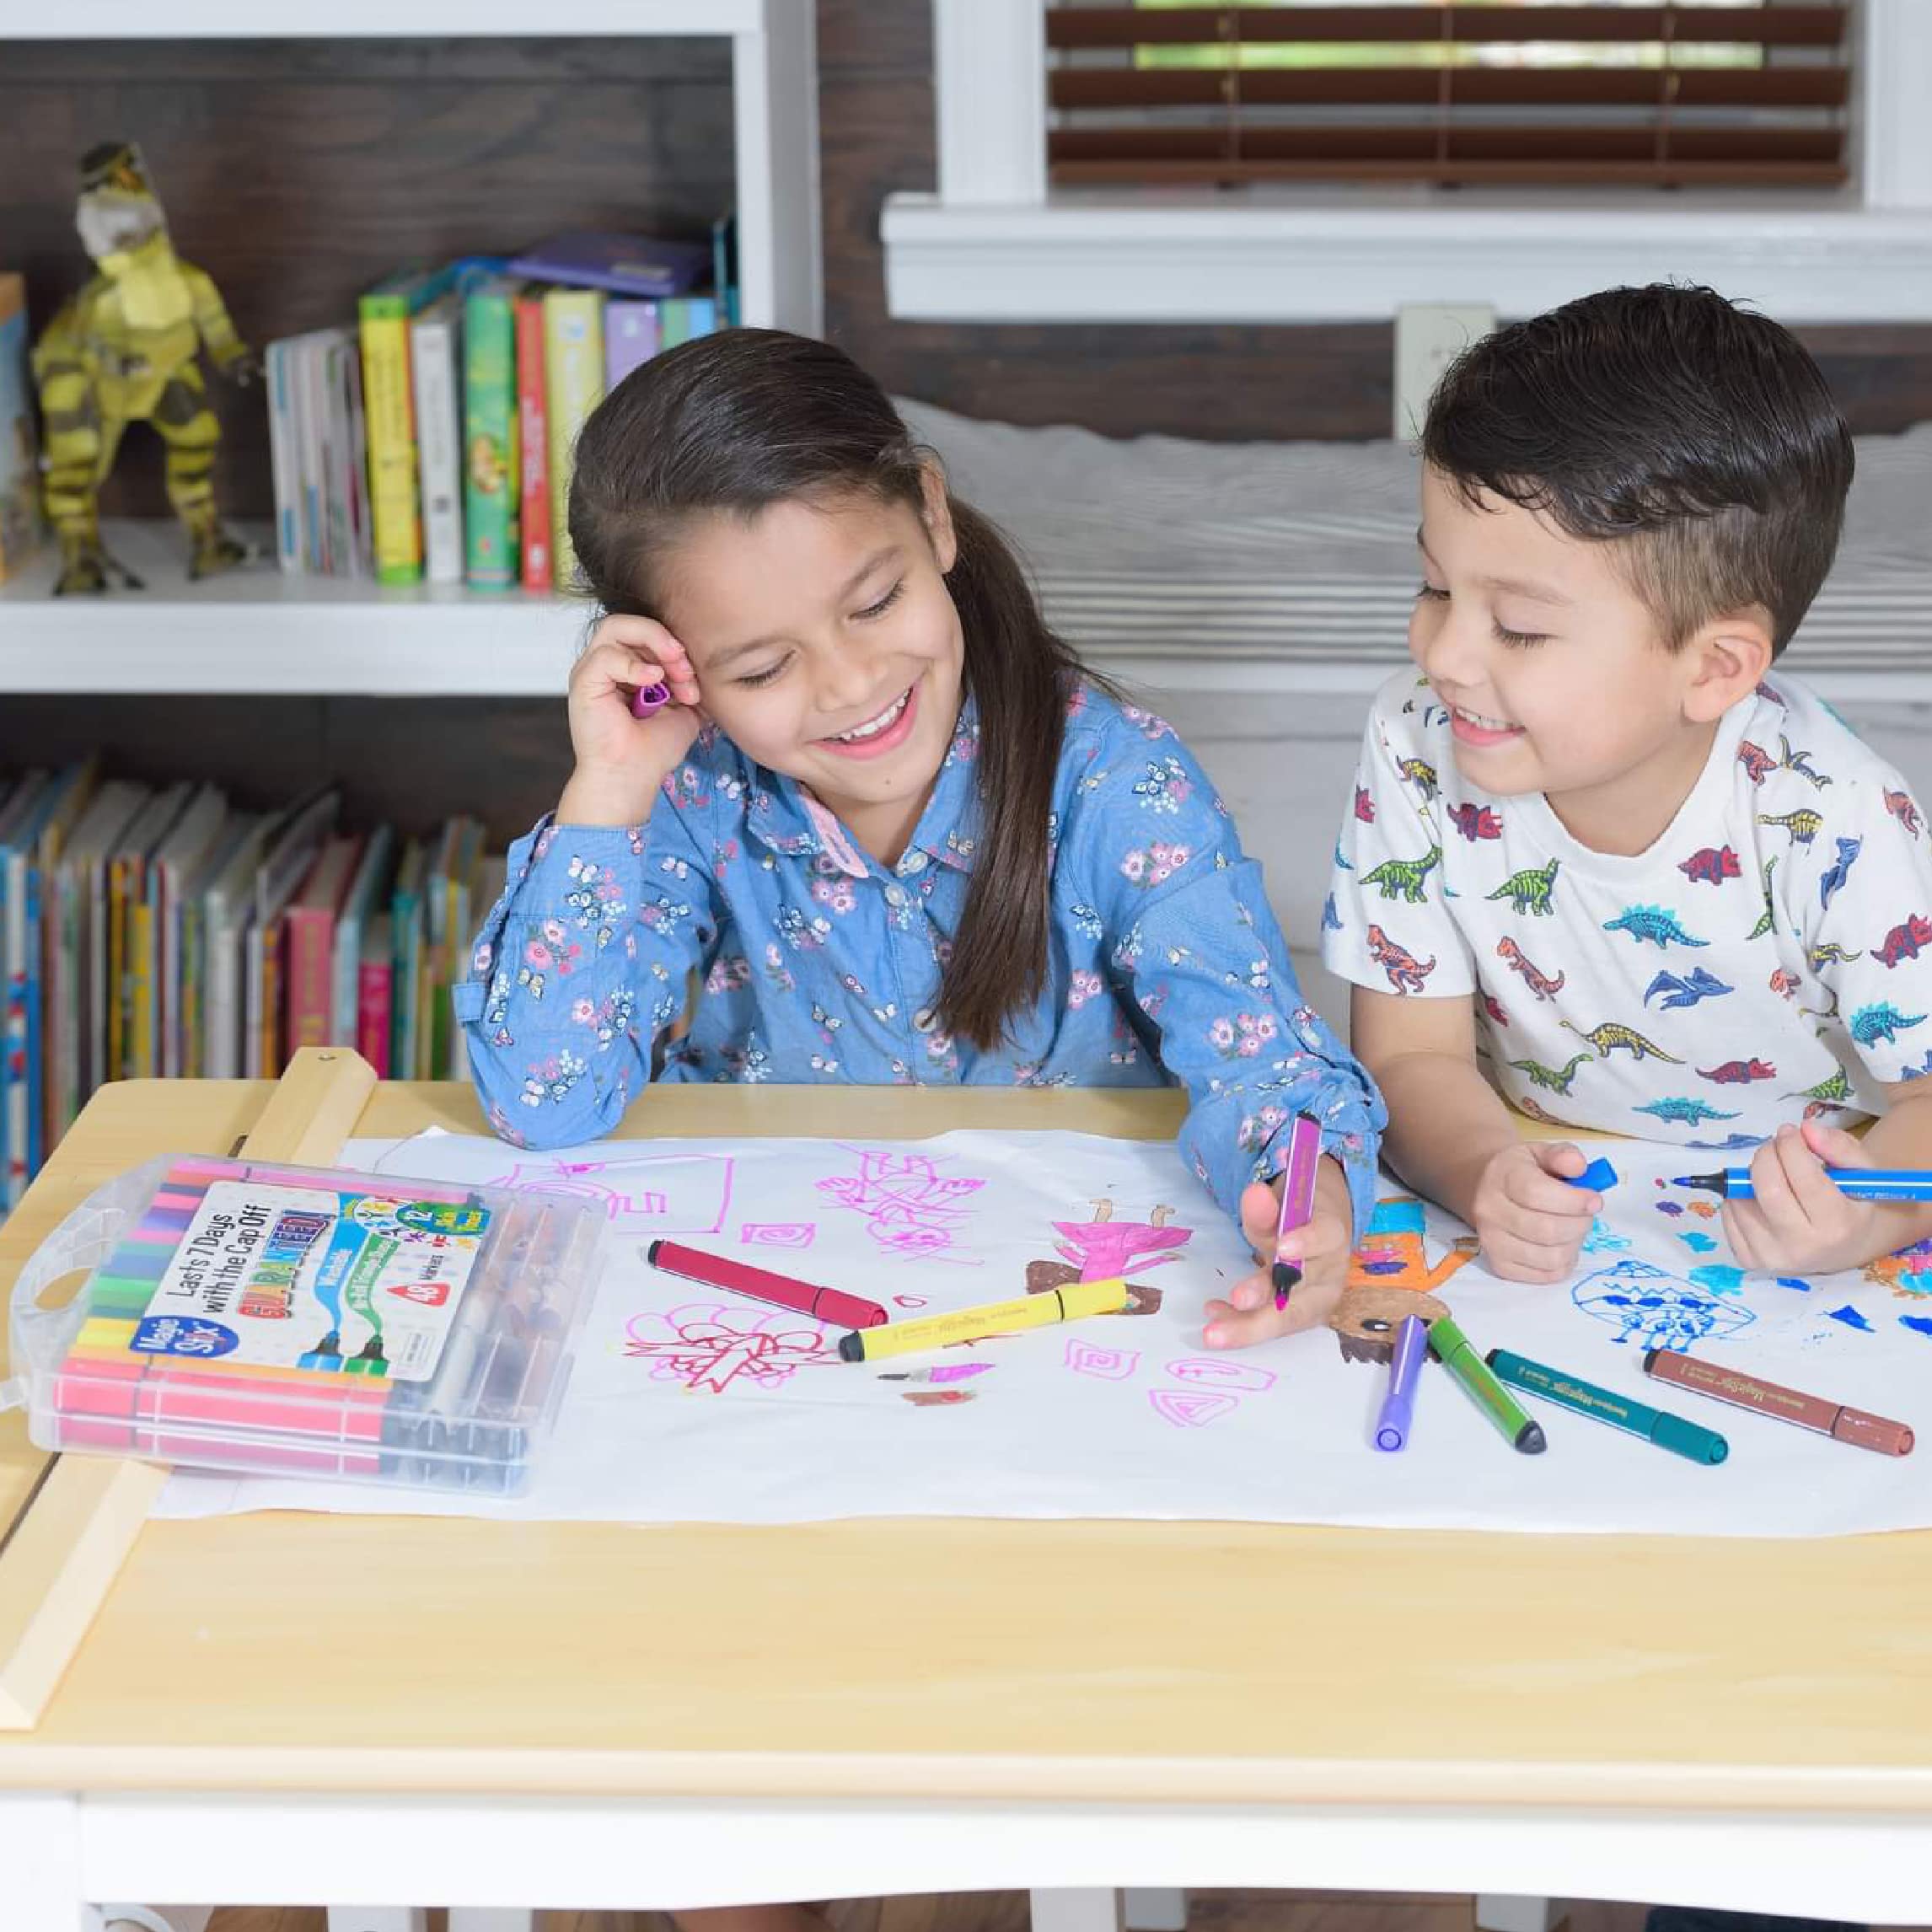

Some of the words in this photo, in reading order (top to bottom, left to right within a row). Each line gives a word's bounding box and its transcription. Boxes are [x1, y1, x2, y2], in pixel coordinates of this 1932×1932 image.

[239, 1204, 271, 1227] Off
[191, 1214, 234, 1248] Days
[224, 1229, 267, 1254] Cap
[185, 1247, 214, 1256] 7
[166, 1258, 209, 1297] Lasts
[212, 1257, 247, 1280] the
[203, 1281, 236, 1313] with
[406, 1285, 439, 1301] 48
[137, 1318, 184, 1349] Magic
